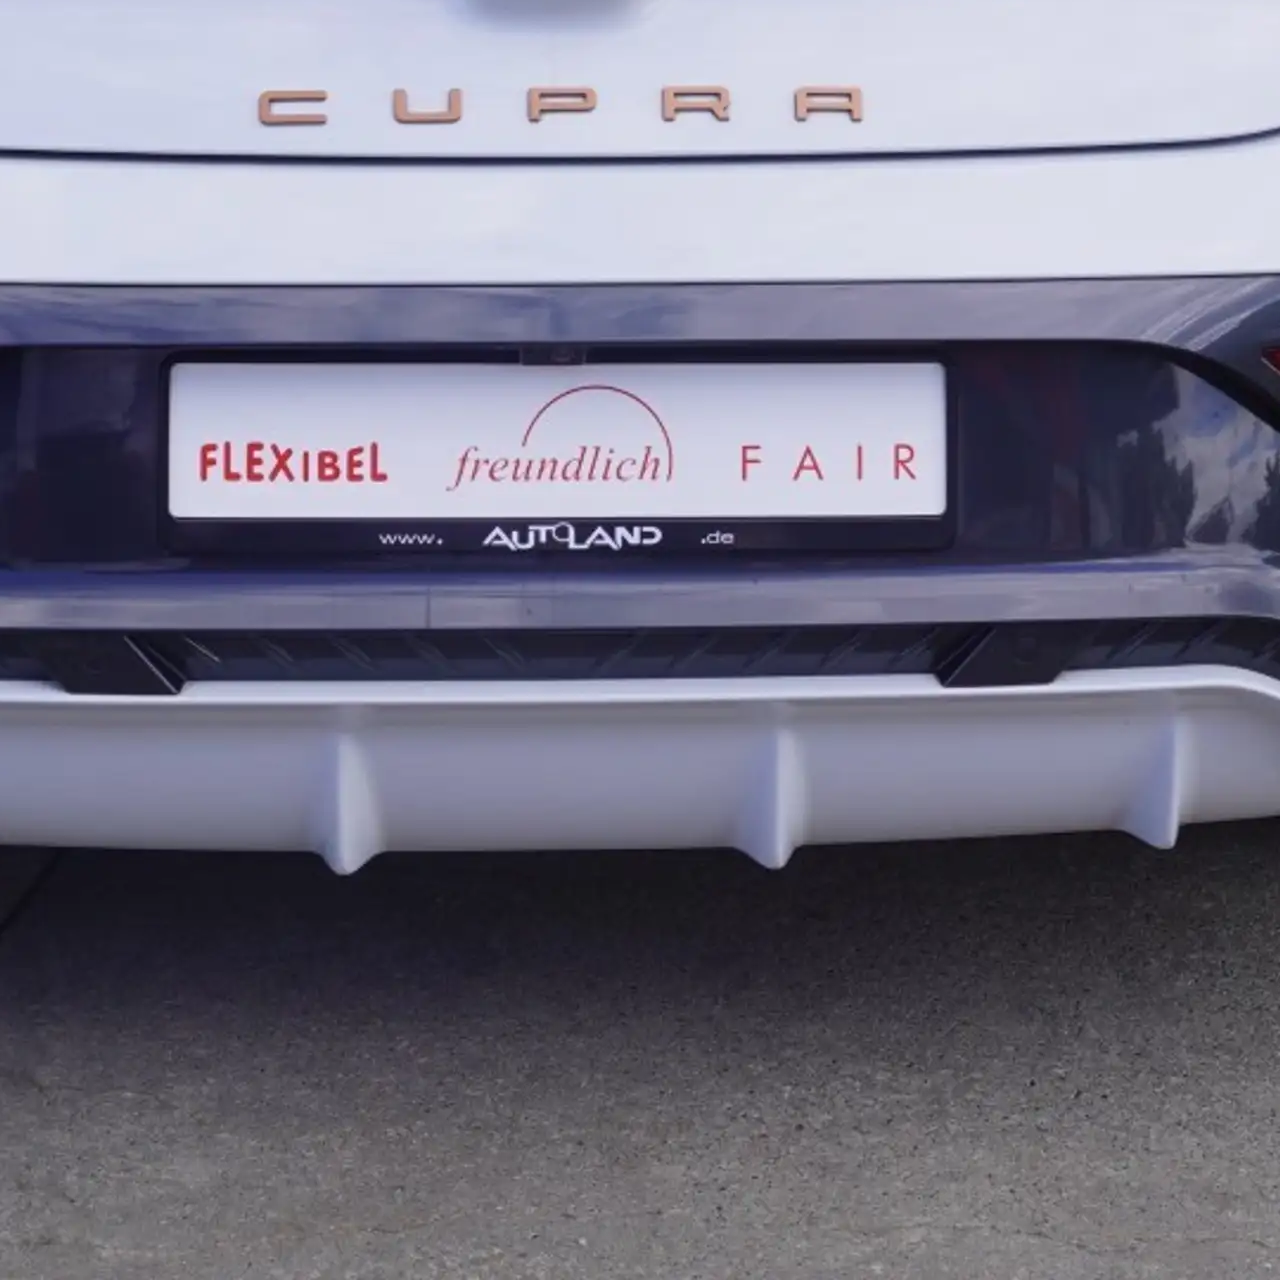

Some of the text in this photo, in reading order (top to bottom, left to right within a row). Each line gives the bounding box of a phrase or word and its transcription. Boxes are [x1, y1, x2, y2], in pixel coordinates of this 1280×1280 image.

[257, 85, 864, 126] CUPRA
[198, 440, 917, 492] FLEXIBEL freundlich FAIR
[378, 520, 735, 552] www. AUTOLAND .de
